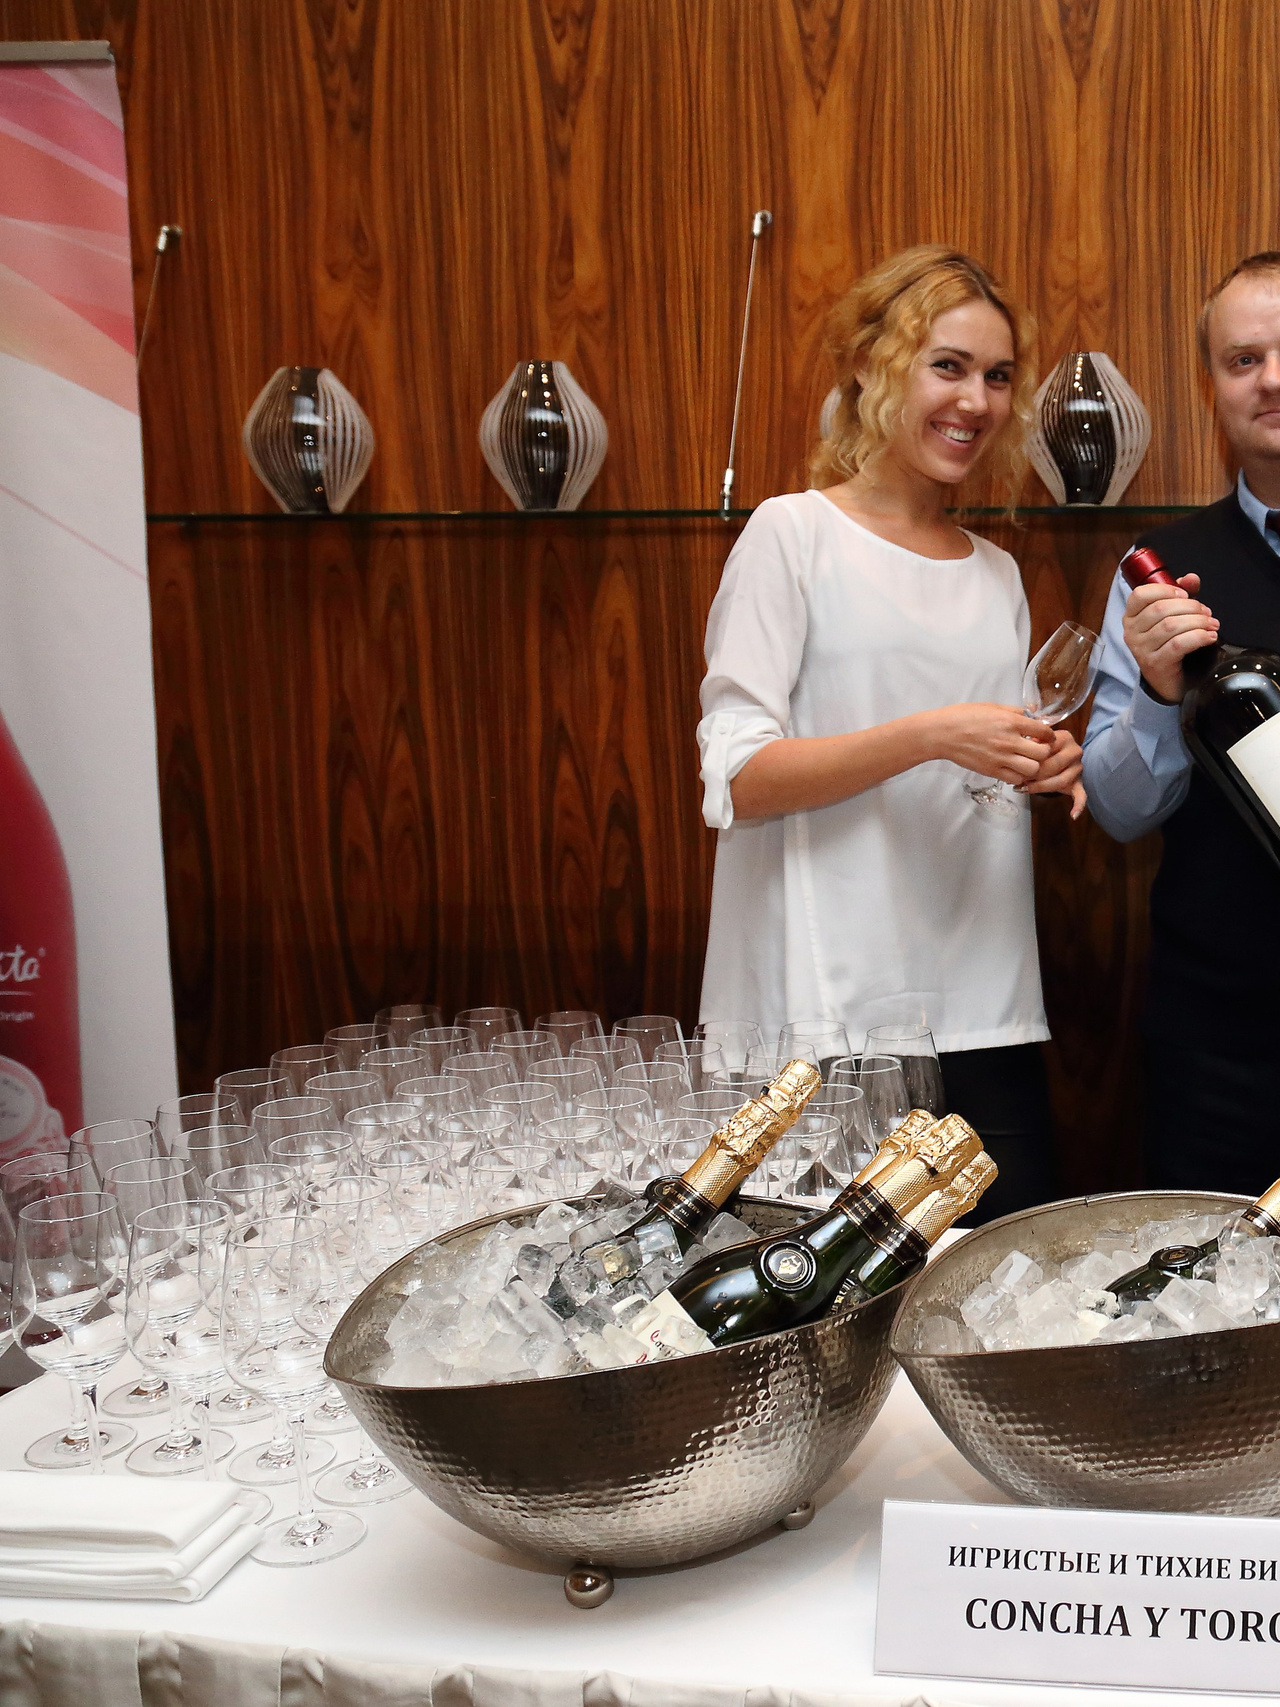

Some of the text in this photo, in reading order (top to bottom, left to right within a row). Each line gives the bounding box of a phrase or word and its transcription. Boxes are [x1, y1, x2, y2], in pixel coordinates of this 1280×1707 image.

[948, 1545, 1100, 1574] ИГРИСТЫЕ
[1108, 1553, 1127, 1575] И
[1136, 1554, 1231, 1580] ТИХИЕ
[965, 1598, 1132, 1637] CONCHA
[1143, 1606, 1170, 1638] Y
